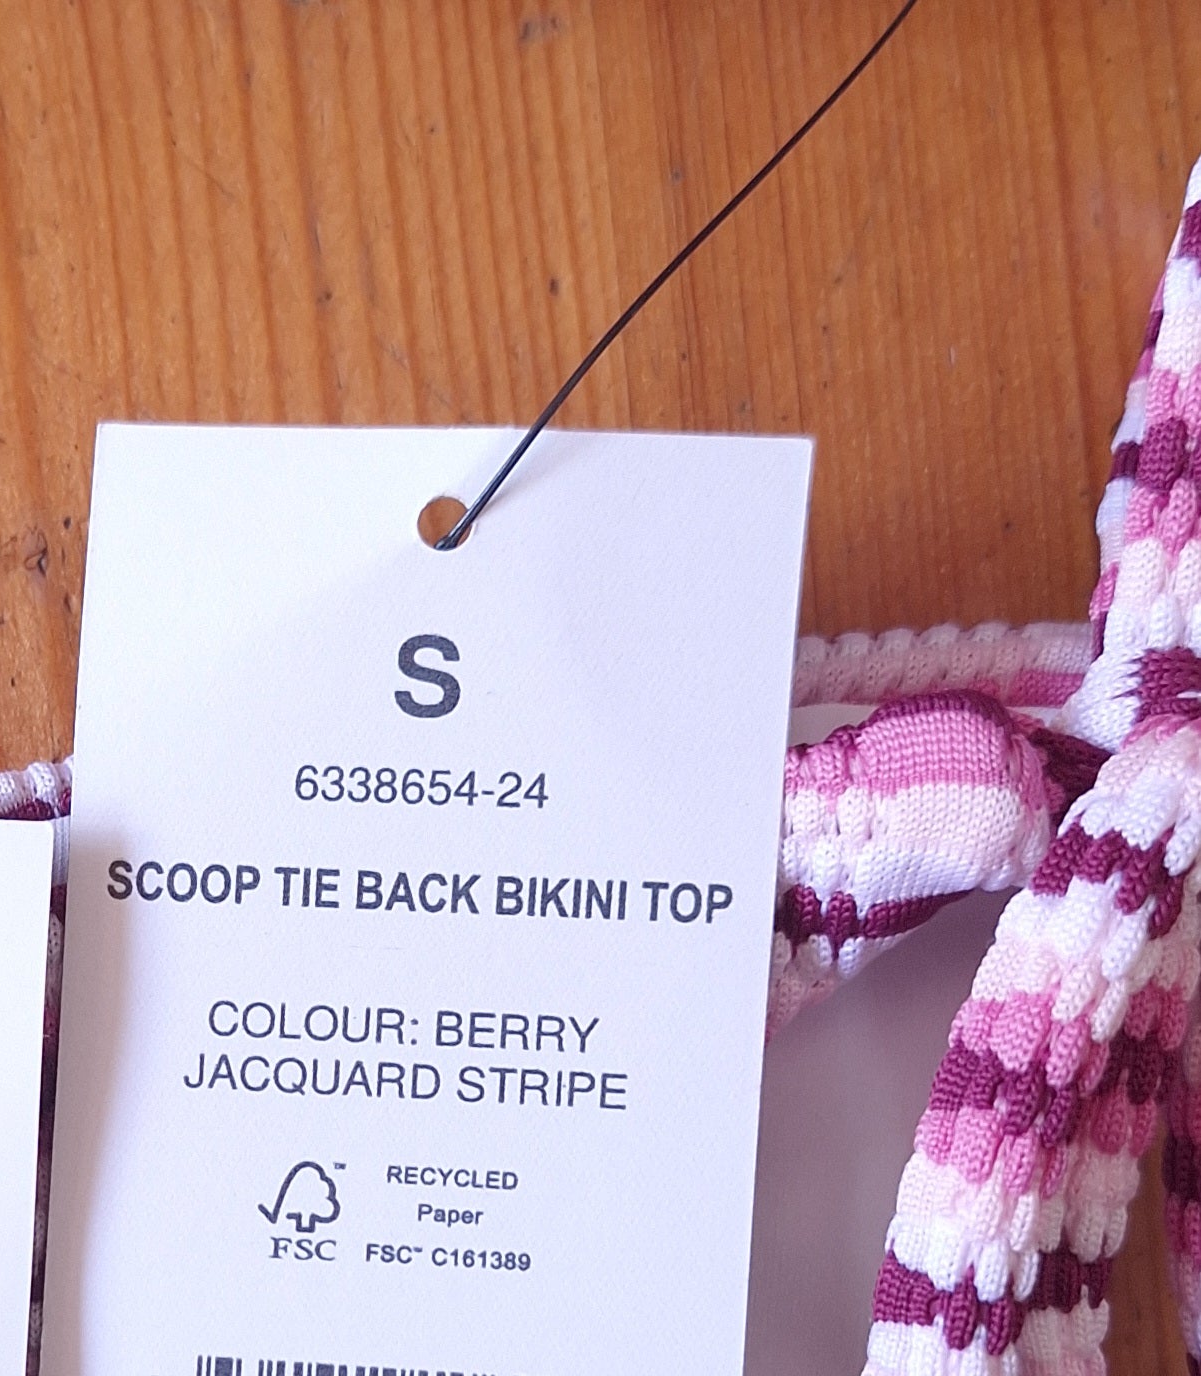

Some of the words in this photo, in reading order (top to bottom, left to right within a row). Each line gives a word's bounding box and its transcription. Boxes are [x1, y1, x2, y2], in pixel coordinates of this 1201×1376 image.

[395, 634, 460, 718] S
[296, 765, 548, 808] 6338654-24
[105, 860, 260, 904] SCOOP
[274, 867, 340, 908] TIE
[356, 870, 481, 914] BACK
[496, 876, 627, 920] BIKINI
[642, 882, 732, 923] TOP
[209, 1001, 418, 1045] COLOUR:
[436, 1011, 599, 1053] BERRY
[184, 1054, 440, 1099] JACQUARD
[457, 1066, 627, 1110] STRIPE
[387, 1166, 518, 1190] RECYCLED
[418, 1204, 483, 1227] Paper
[270, 1237, 336, 1261] FSC
[432, 1248, 530, 1271] C161389
